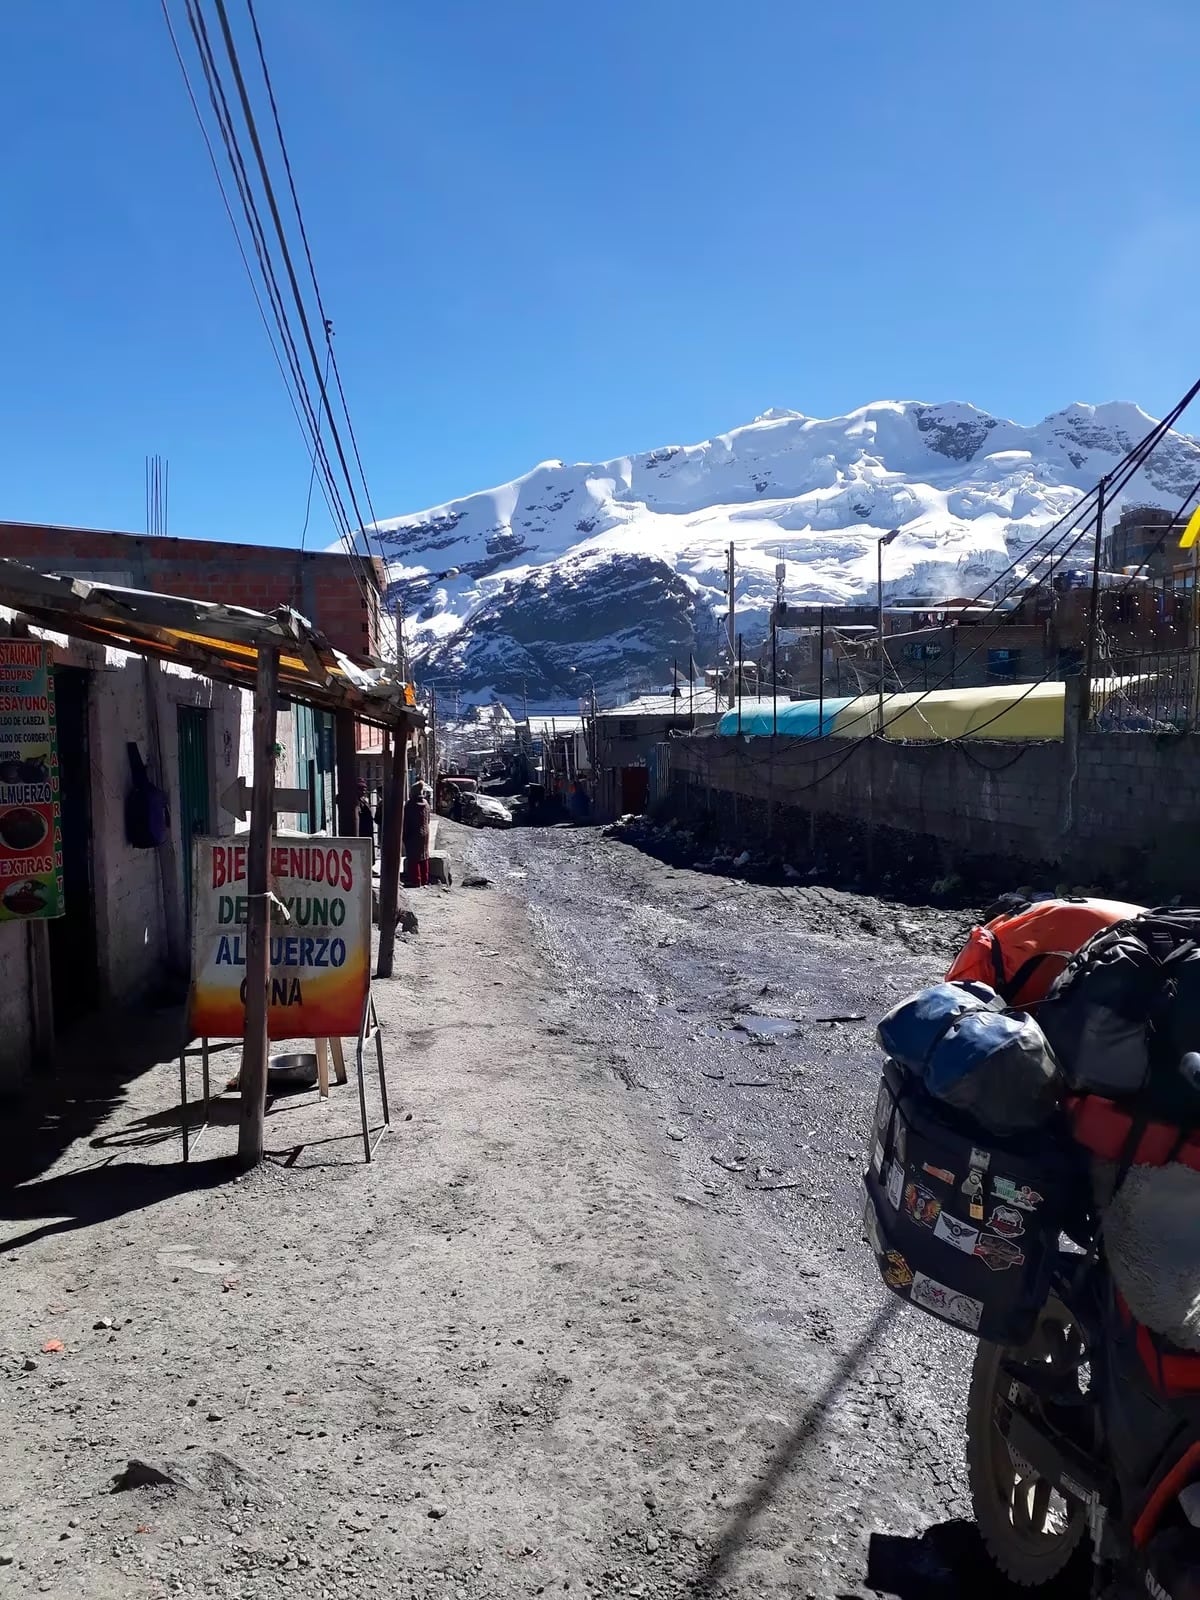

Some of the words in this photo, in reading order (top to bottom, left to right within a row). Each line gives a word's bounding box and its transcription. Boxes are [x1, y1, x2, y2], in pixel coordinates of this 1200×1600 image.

[13, 716, 21, 726] DE
[23, 715, 45, 726] CABEZA
[14, 733, 22, 743] DE
[0, 783, 51, 804] LMUERZO
[0, 857, 53, 875] EXTRAS
[212, 846, 353, 892] BIEENIDOS
[218, 895, 346, 927] DEYUNO
[215, 936, 346, 967] ALUERZO
